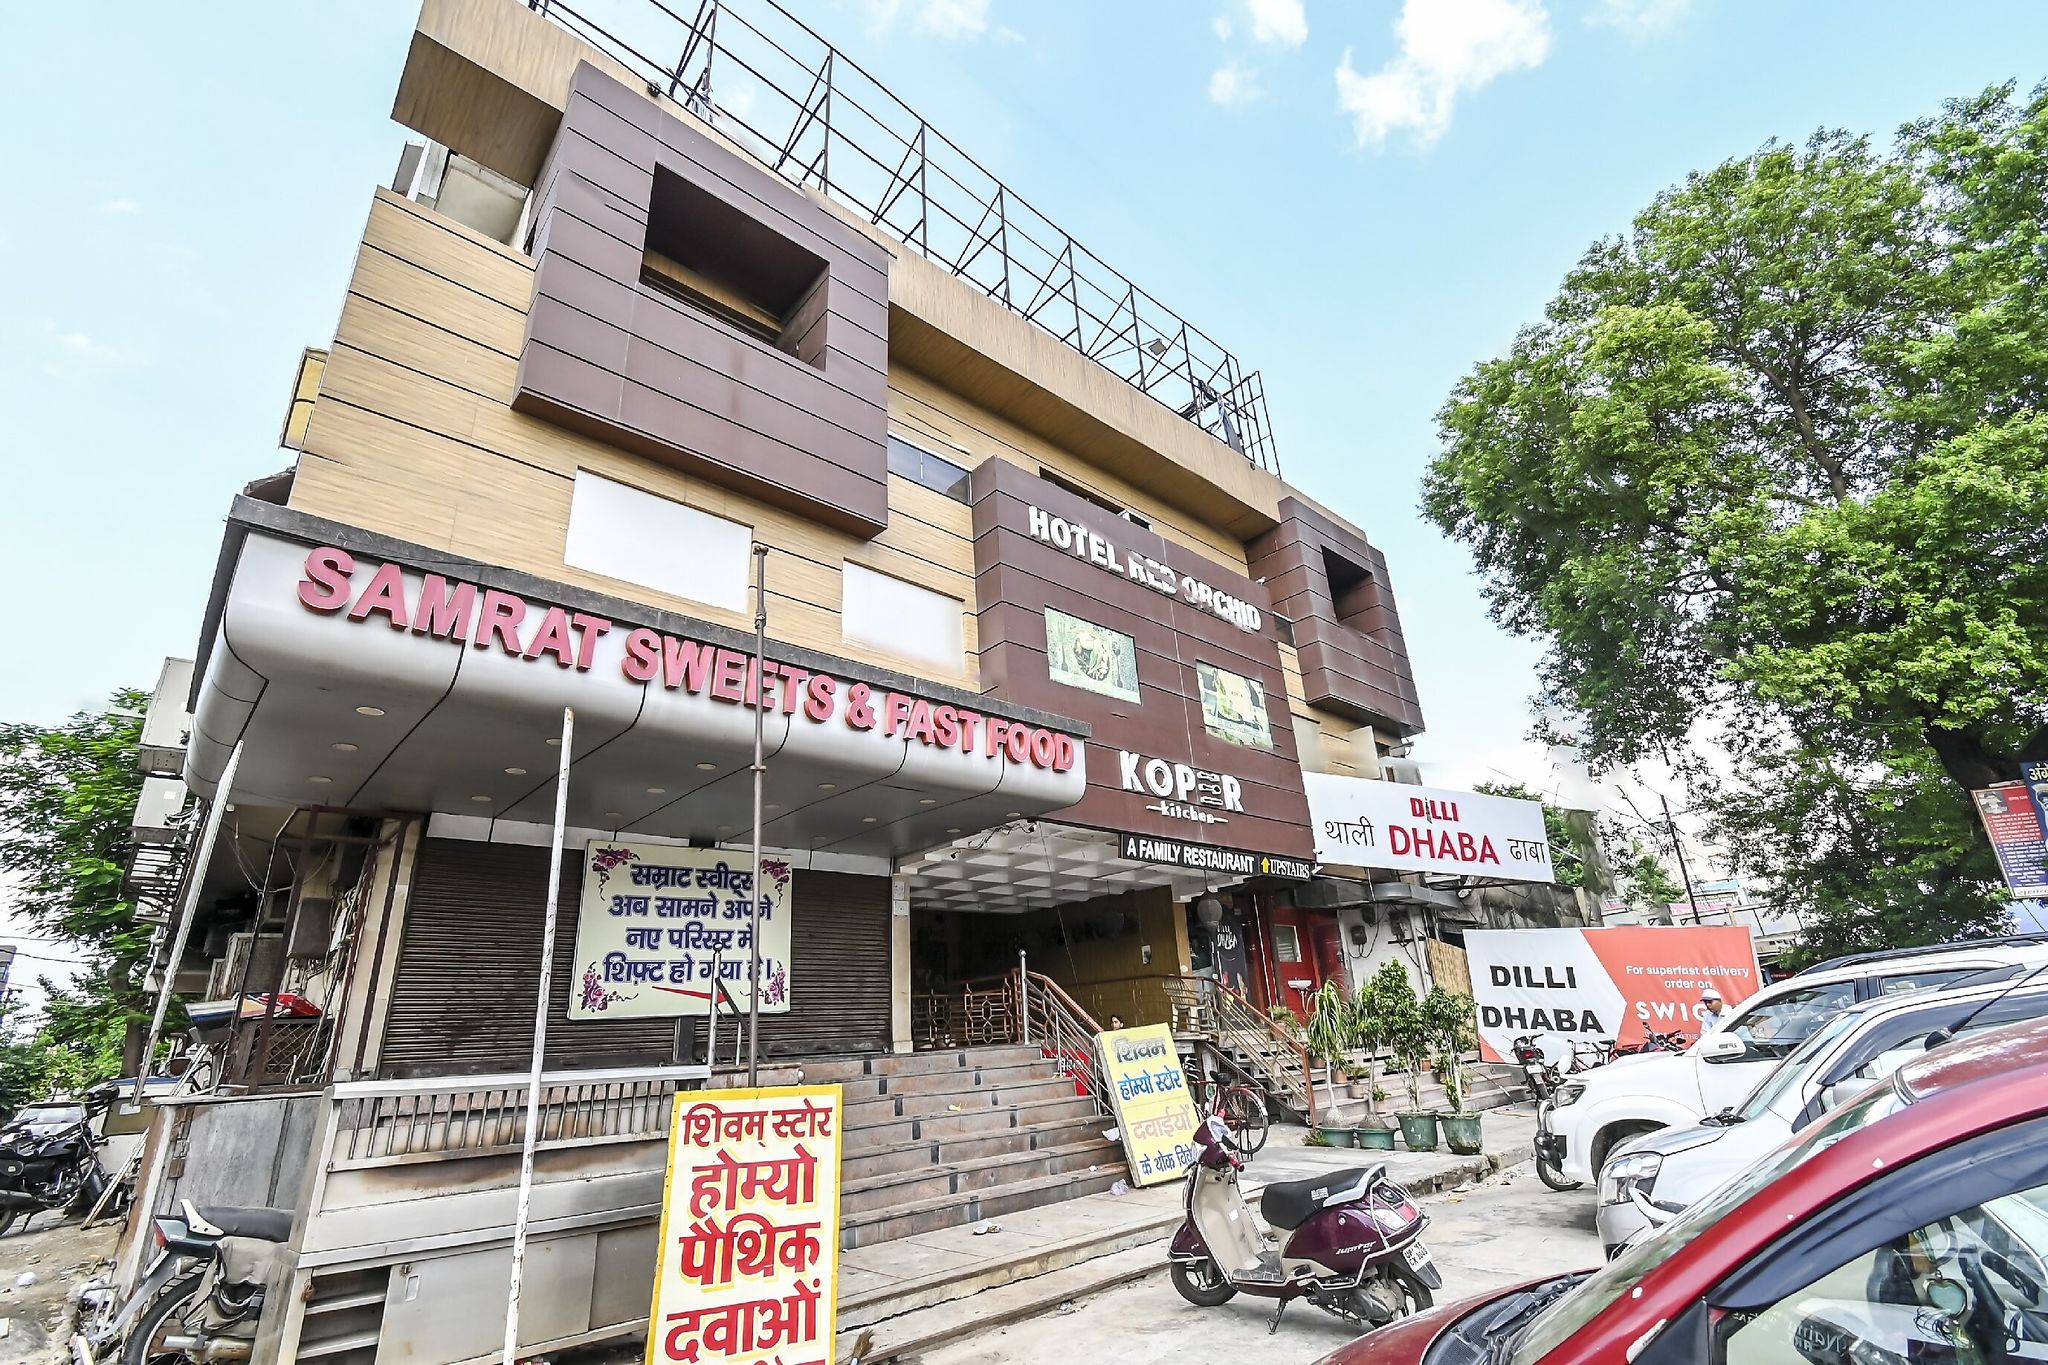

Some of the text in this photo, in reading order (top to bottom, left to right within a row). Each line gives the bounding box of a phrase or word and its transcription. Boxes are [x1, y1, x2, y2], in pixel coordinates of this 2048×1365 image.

[1028, 505, 1124, 574] HOTEL
[1181, 576, 1262, 634] ORCHID
[298, 547, 1074, 773] SAMRAT SWEETS & FAST FOOD
[1410, 797, 1459, 823] DILLI
[1325, 816, 1374, 846] थाली
[1389, 825, 1500, 865] DHABA
[1126, 838, 1254, 874] A FAMILY RESTAURANT
[1507, 838, 1546, 863] ढाबा
[631, 864, 692, 890] सम्राट
[1269, 860, 1310, 879] UPSTAIRS
[609, 891, 773, 920] अब सामने अपने
[626, 927, 662, 949] नए
[668, 921, 733, 950] परिसर
[669, 953, 695, 983] हो
[699, 960, 742, 980] गया
[1490, 965, 1576, 988] DILLI
[1626, 965, 1749, 978] For superfast delivery
[1664, 979, 1713, 989] order on
[1481, 1006, 1605, 1033] DHABA
[1117, 1065, 1183, 1101] होम्यो स्टोर
[772, 1098, 833, 1138] स्टोर
[1140, 1153, 1152, 1176] के
[1154, 1150, 1175, 1172] थोक
[690, 1143, 818, 1219] होम्यो
[679, 1213, 821, 1286] पैथिक
[664, 1278, 822, 1364] दवाओं
